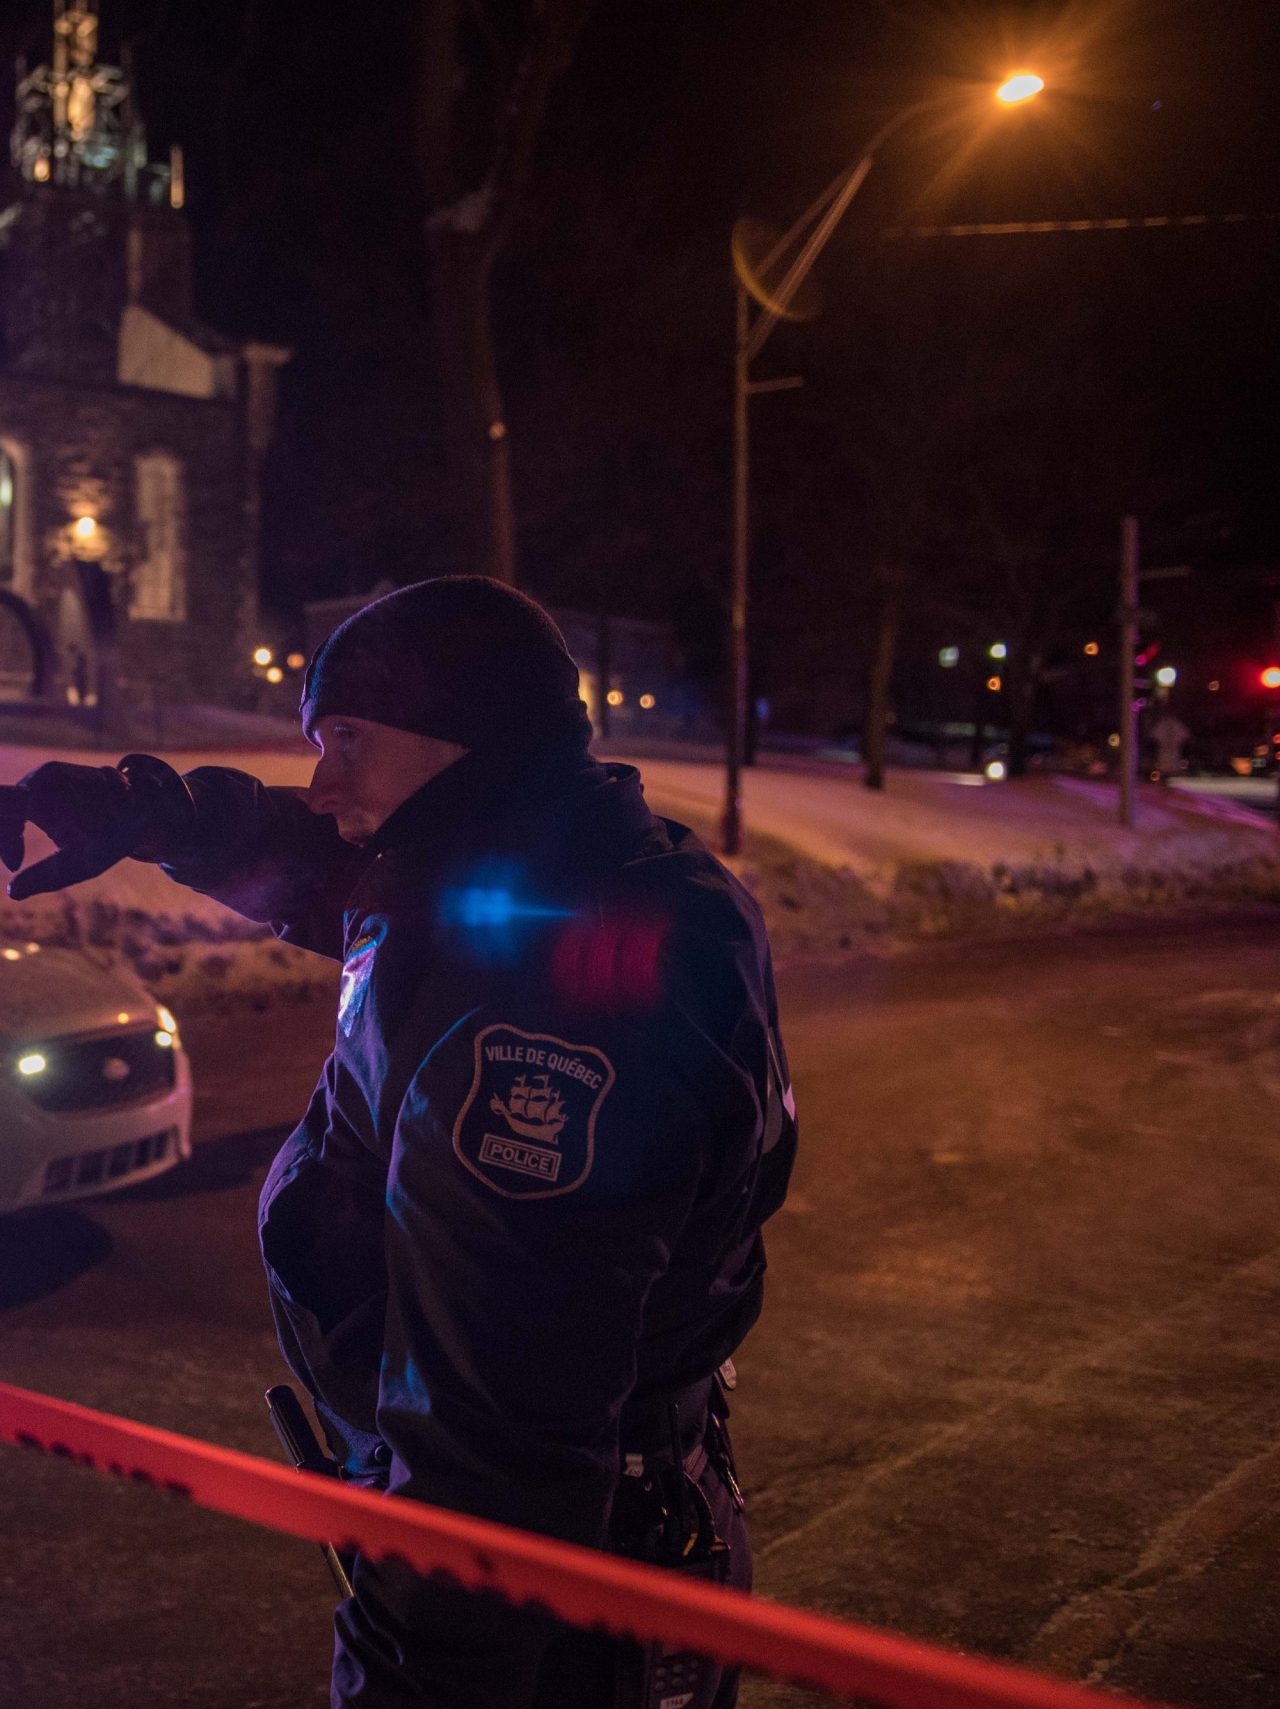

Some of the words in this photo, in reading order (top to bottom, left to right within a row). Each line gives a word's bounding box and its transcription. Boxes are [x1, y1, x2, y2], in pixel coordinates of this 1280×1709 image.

[485, 1045, 524, 1063] VILLE
[525, 1048, 546, 1066] DE
[548, 1053, 602, 1089] QUÉBEC
[490, 1144, 551, 1172] POLICE
